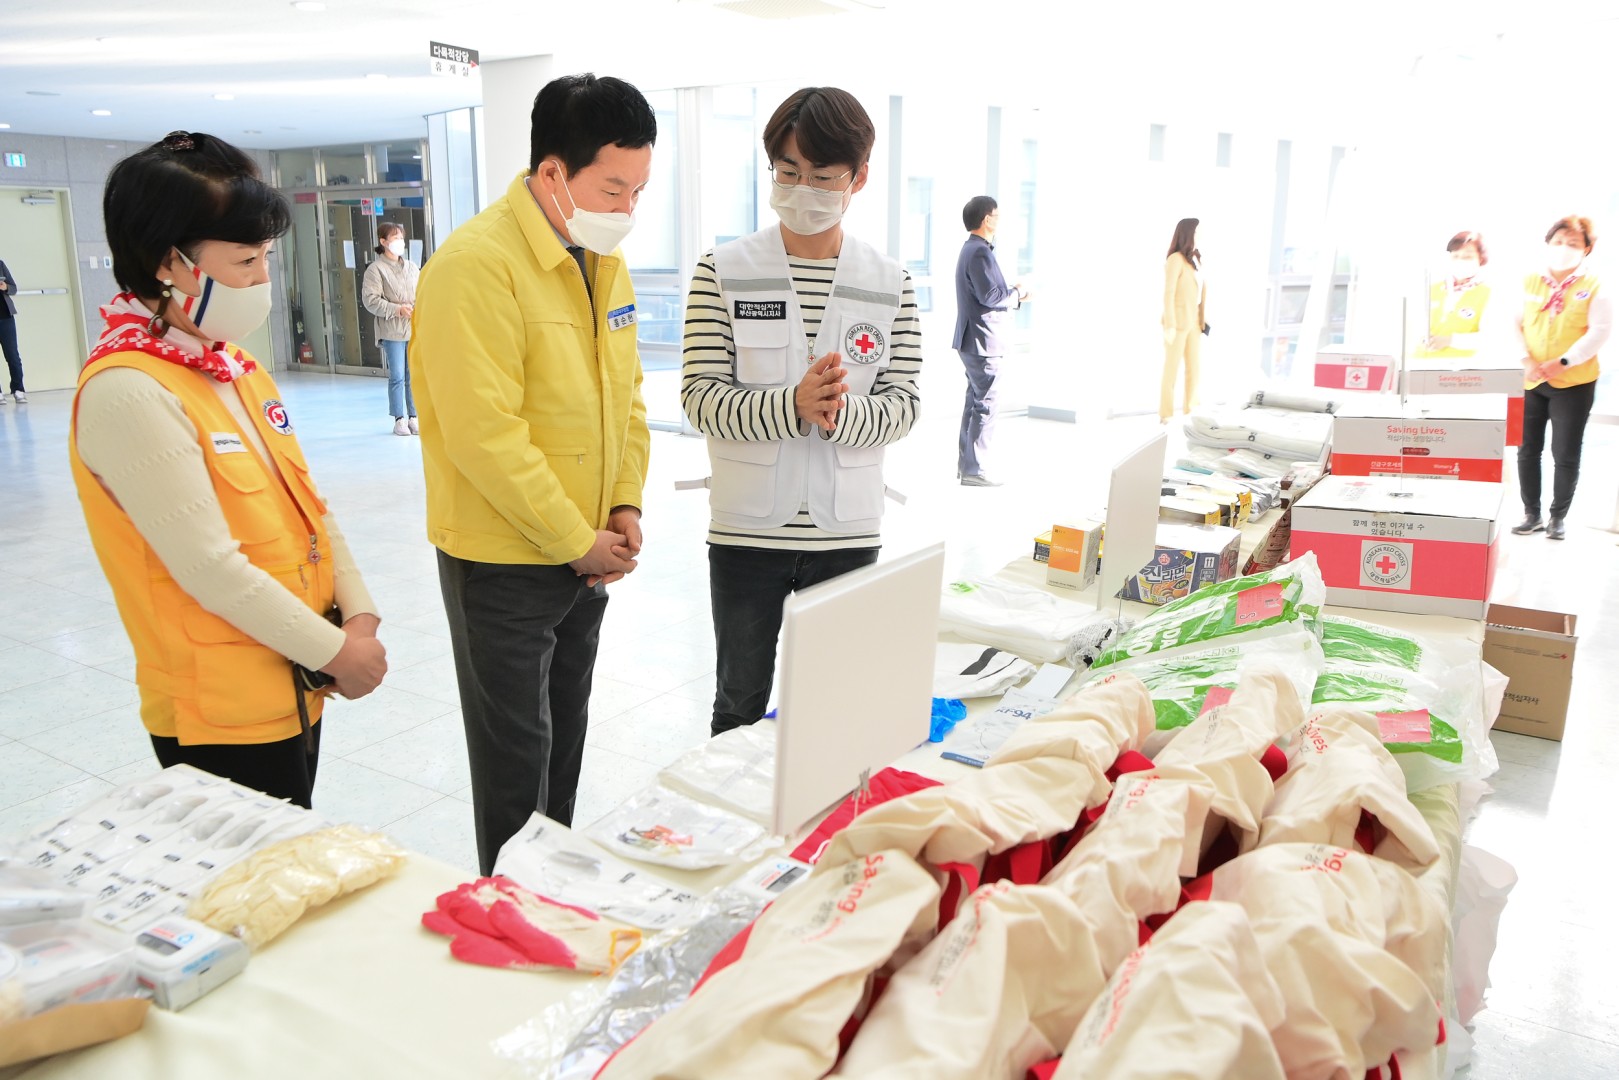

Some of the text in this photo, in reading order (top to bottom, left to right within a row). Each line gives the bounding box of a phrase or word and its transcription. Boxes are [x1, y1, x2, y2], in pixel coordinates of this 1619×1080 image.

[433, 45, 469, 63] 다목적강당
[739, 303, 782, 311] 대한적십자사
[849, 325, 864, 340] KOREAN
[864, 325, 874, 333] RED
[1420, 427, 1447, 436] Lives,
[1352, 520, 1368, 528] 함께
[1371, 521, 1387, 529] 하면
[1417, 523, 1425, 532] 수
[1371, 528, 1405, 537] 있습니다.
[1366, 546, 1383, 565] KOREAN
[1394, 550, 1406, 567] CROSS
[1138, 564, 1187, 584] 진라면
[837, 854, 884, 914] Saing
